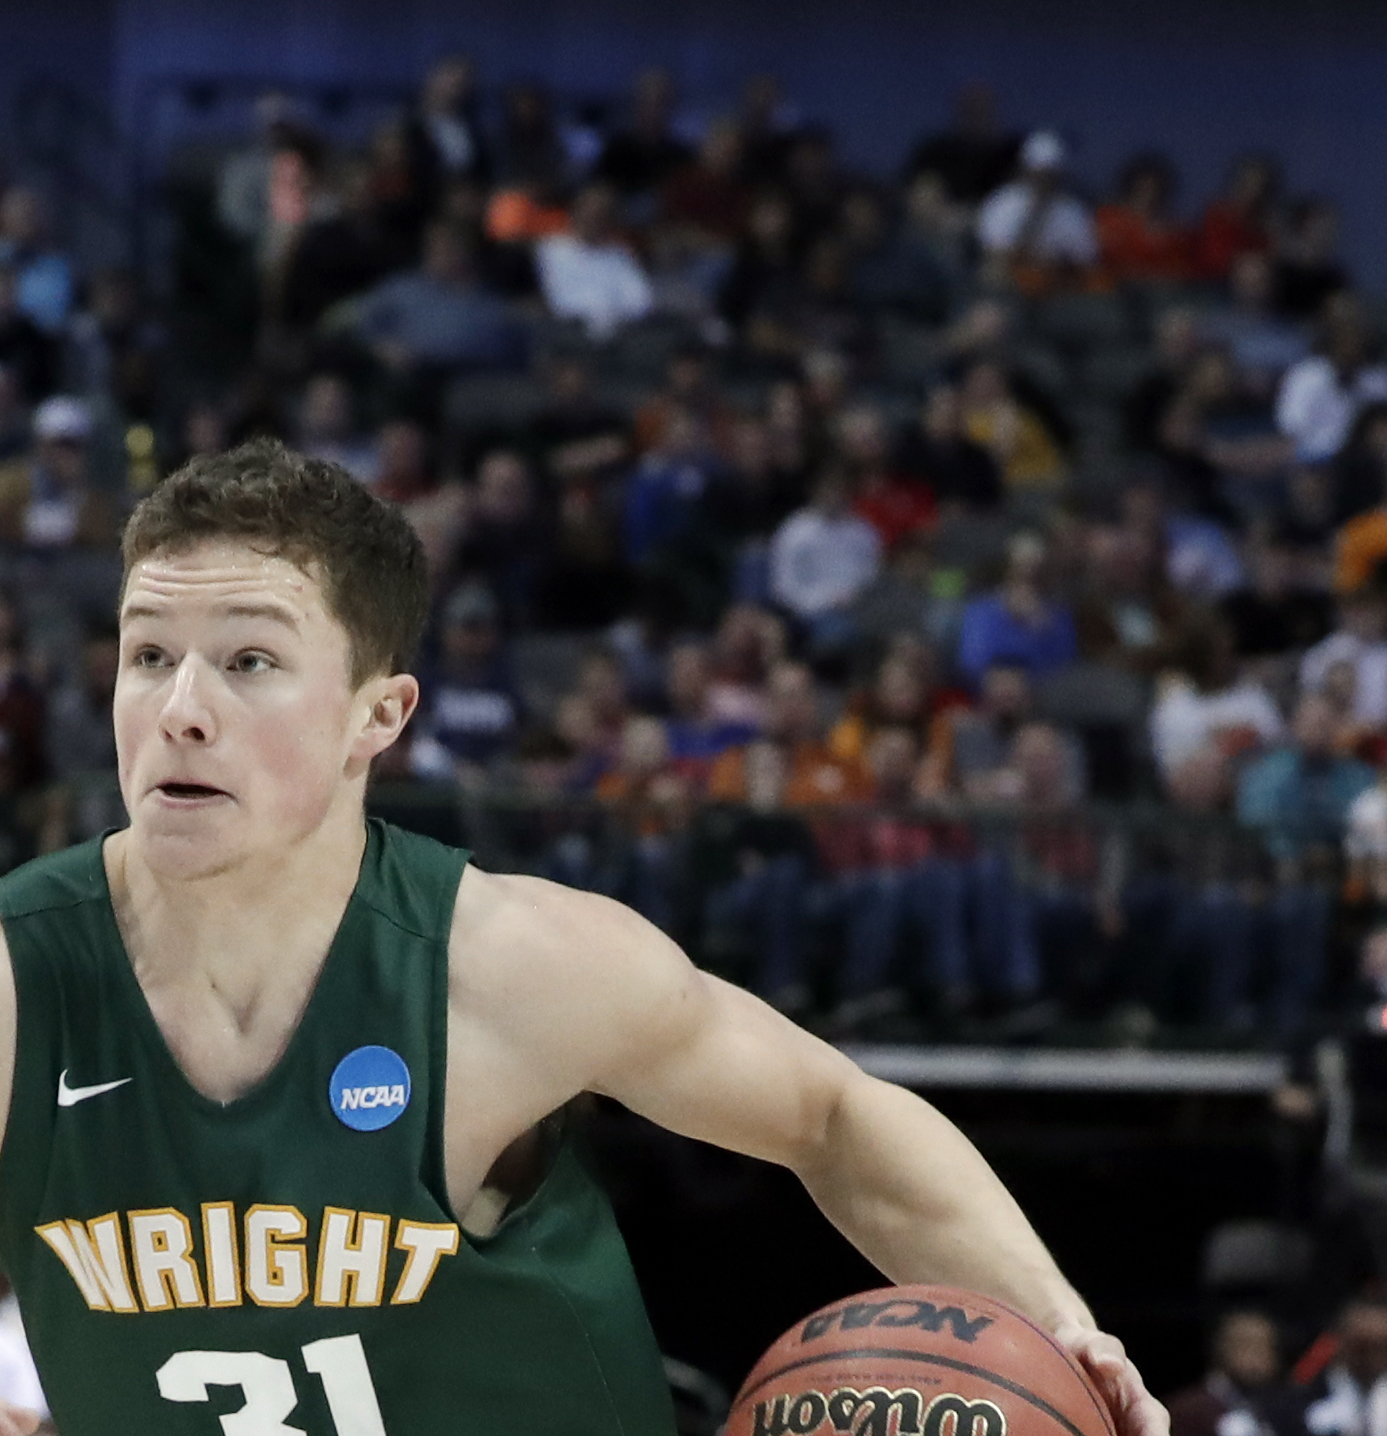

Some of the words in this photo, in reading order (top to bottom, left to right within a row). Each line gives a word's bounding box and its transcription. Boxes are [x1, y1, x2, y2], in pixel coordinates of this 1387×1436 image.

[340, 1084, 405, 1110] NCAA
[33, 1201, 459, 1313] WRIGHT
[801, 1299, 995, 1344] NCAA
